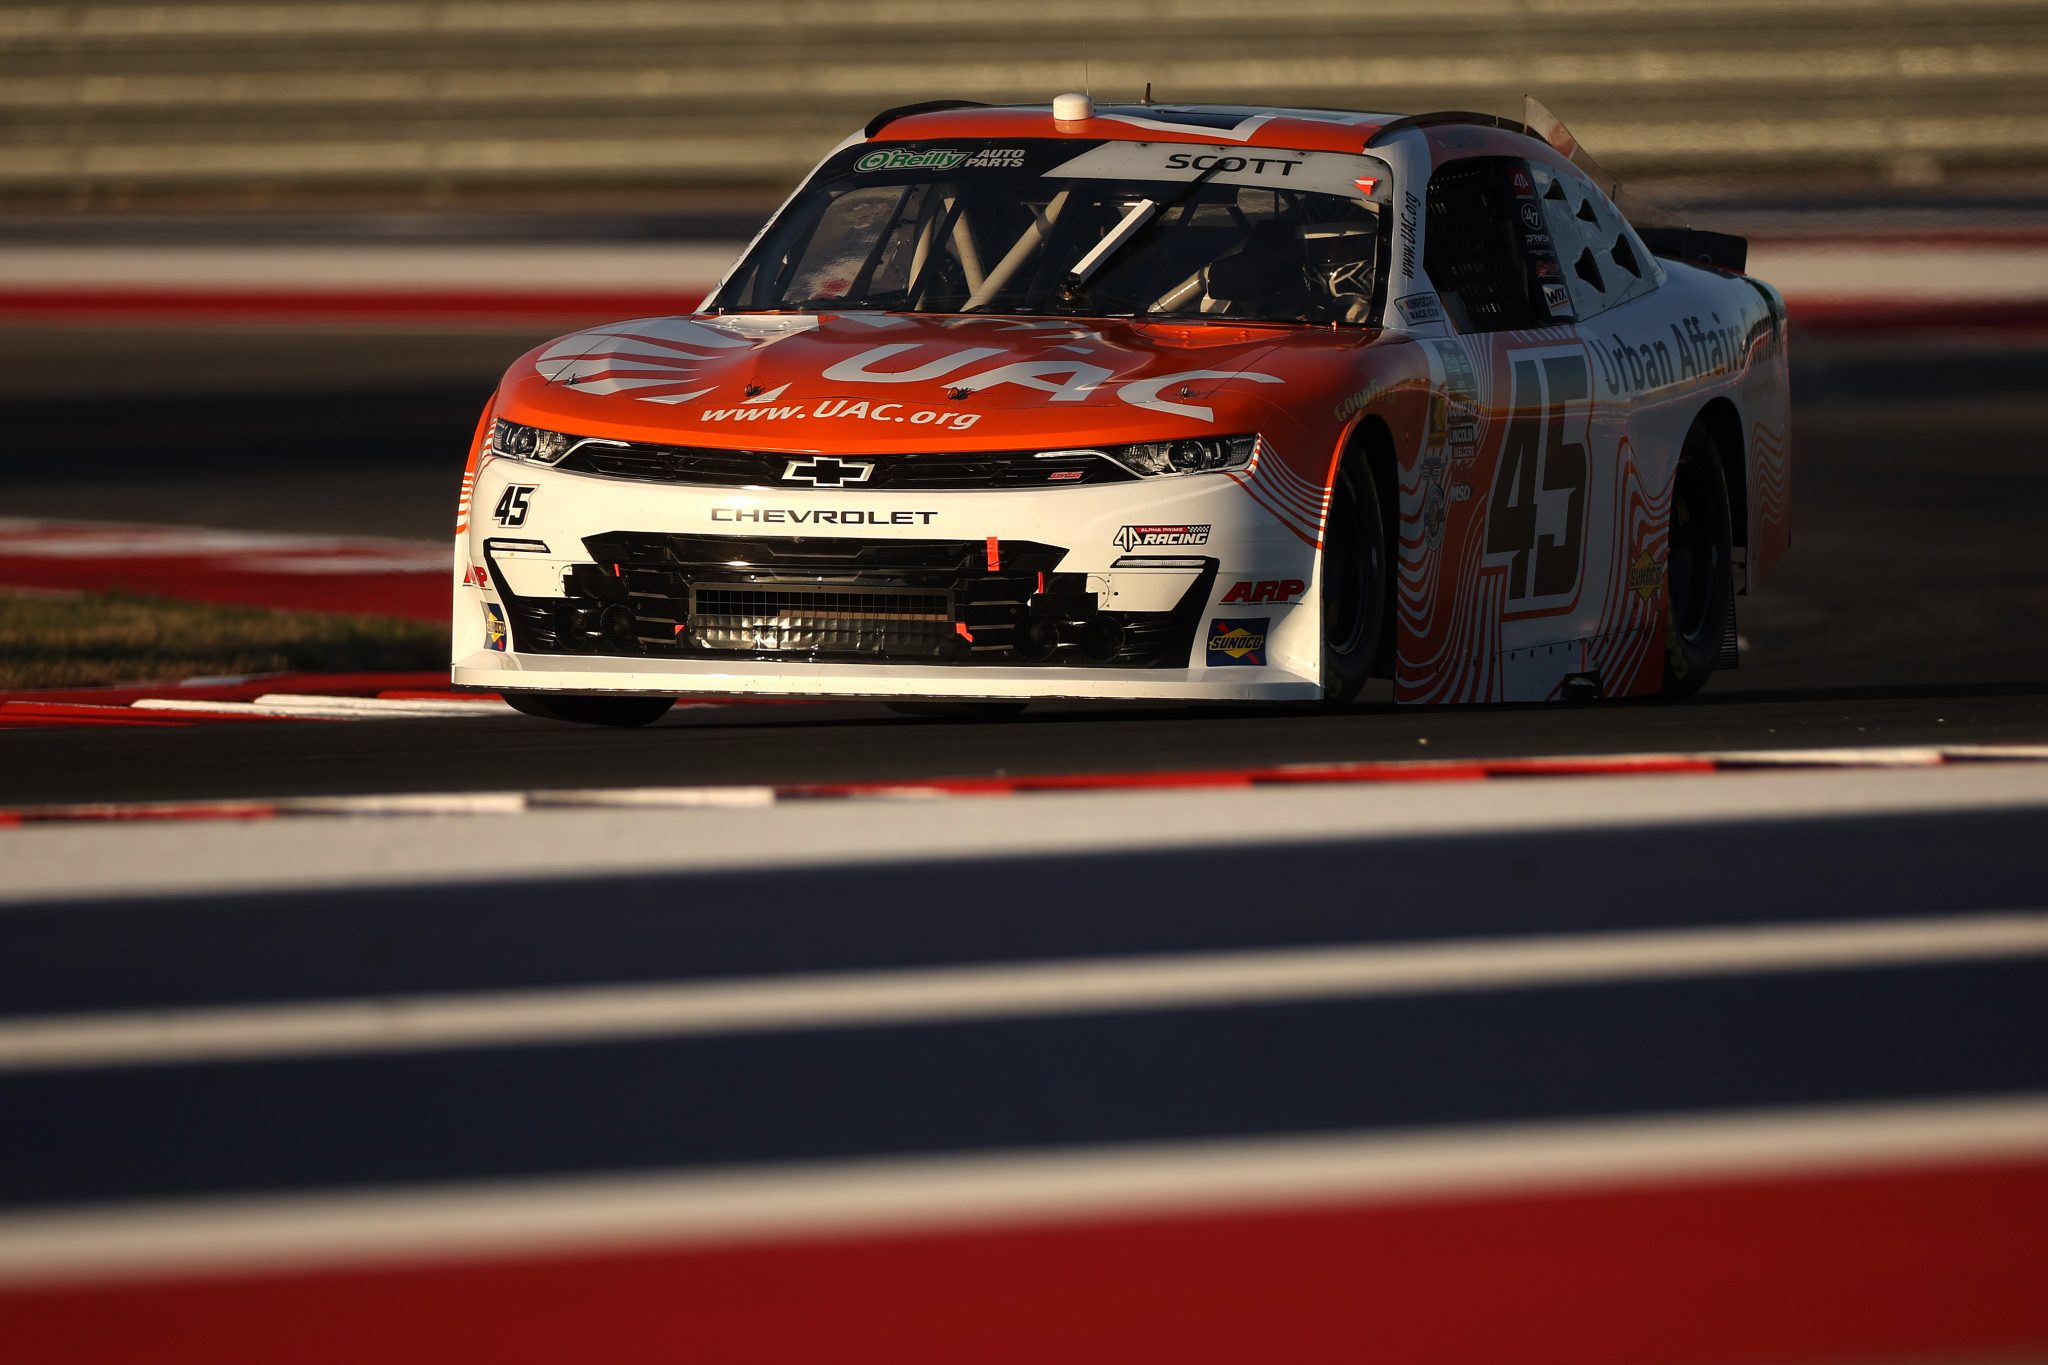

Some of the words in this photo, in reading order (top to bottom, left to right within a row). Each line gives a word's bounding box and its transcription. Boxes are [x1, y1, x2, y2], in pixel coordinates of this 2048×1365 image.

[857, 148, 968, 170] O'Reilly
[964, 158, 1025, 168] PARTS
[976, 149, 1026, 158] AUTO
[1165, 153, 1303, 176] SCOTT
[1400, 191, 1421, 280] www.UAC.org
[1546, 287, 1567, 304] WIX
[1588, 333, 1674, 396] Urban
[822, 343, 1286, 422] UAC
[701, 399, 982, 431] www.UAC.org
[1486, 355, 1588, 600] 45
[494, 485, 533, 526] 45
[710, 507, 938, 525] CHEVROLET
[1143, 532, 1208, 545] RACING
[1220, 579, 1305, 603] ARP
[1210, 635, 1262, 650] SUNOCO
